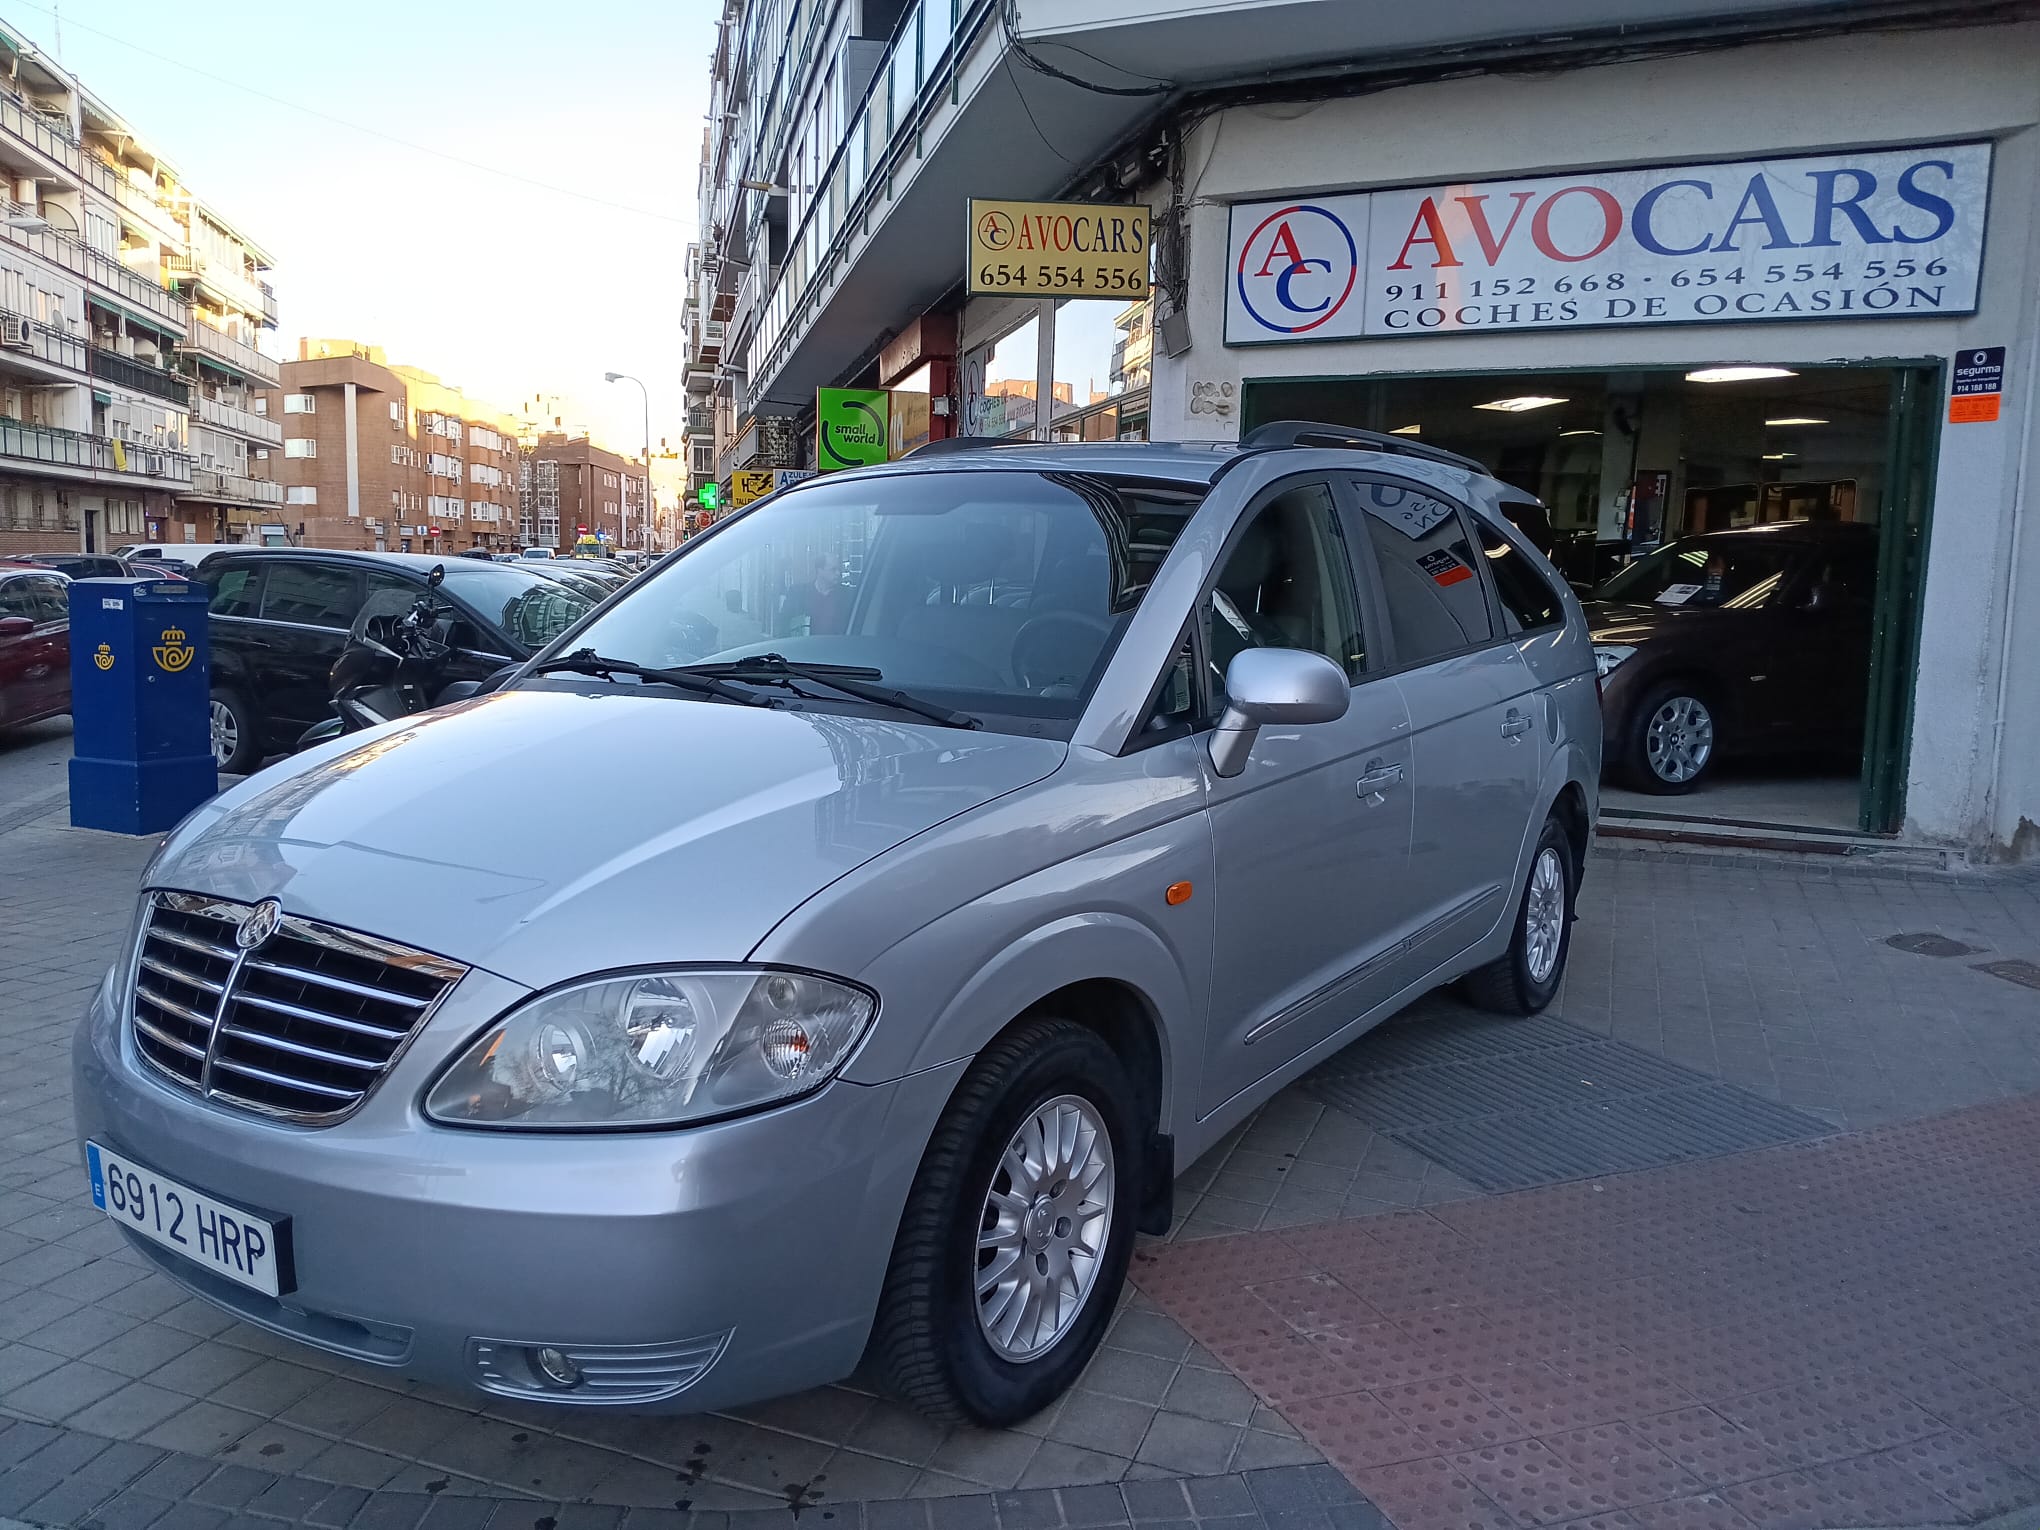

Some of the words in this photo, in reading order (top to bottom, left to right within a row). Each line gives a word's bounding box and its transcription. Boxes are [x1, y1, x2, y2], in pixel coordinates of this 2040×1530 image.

[1386, 160, 1955, 270] AVOCARS
[1017, 213, 1143, 254] AVOCARS
[980, 264, 1028, 286] 654
[1037, 266, 1085, 288] 554
[1094, 267, 1142, 290] 556
[1385, 282, 1448, 302] 911
[1471, 277, 1537, 297] 152
[1554, 272, 1625, 293] 668
[1671, 267, 1746, 288] 654
[1764, 262, 1844, 283] 554
[1863, 257, 1948, 279] 556
[1384, 301, 1578, 329] COCHES
[1605, 297, 1667, 319] DE
[1693, 282, 1946, 316] OCASIÓN
[1956, 365, 2001, 377] segurma
[834, 424, 867, 434] small
[843, 433, 876, 444] world
[95, 1184, 102, 1197] E
[107, 1163, 187, 1245] 6912
[196, 1203, 265, 1276] HRP
